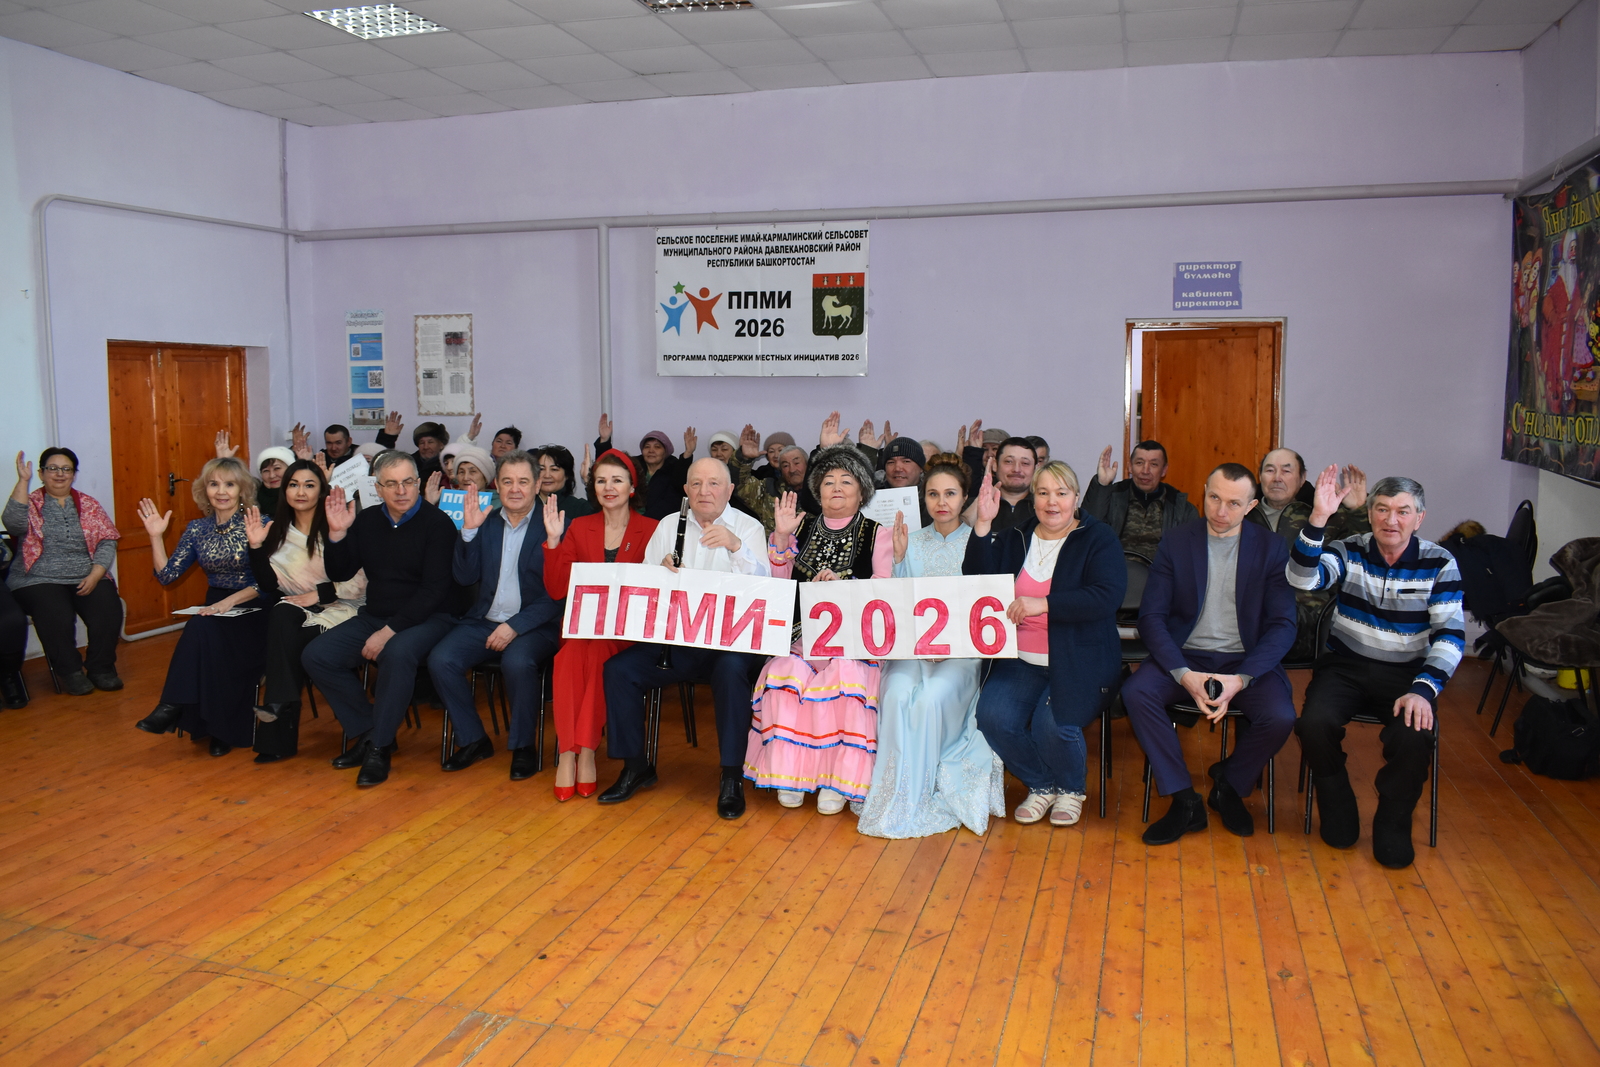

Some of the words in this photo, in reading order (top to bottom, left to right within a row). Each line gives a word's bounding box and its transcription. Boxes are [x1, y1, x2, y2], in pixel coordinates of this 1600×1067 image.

[656, 235, 694, 245] СЕЛЬСКОЕ
[695, 234, 739, 244] ПОСЕЛЕНИЕ
[740, 230, 823, 243] ИМАЙ-КАРМАЛИНСКИЙ
[824, 229, 869, 241] СЕЛЬСОВЕТ
[663, 246, 732, 257] МУНИЦИПАЛЬНОГО
[733, 244, 763, 255] РАЙОНА
[764, 242, 834, 256] ДАВЛЕКАНОВСКИЙ
[835, 241, 861, 252] РАЙОН
[707, 258, 754, 268] РЕСПУБЛИКИ
[756, 257, 816, 267] БАШКОРТОСТАН
[1179, 263, 1237, 271] директор
[728, 290, 792, 310] ППМИ
[1182, 290, 1233, 298] кабинет
[1175, 300, 1239, 308] директора
[734, 318, 785, 338] 2026
[663, 354, 707, 362] ПРОГРАММА
[708, 354, 754, 362] ПОДДЕРЖКИ
[793, 354, 840, 362] ИНИЦИАТИВ
[841, 353, 860, 361] 2026
[442, 492, 489, 505] ППИ
[568, 584, 787, 650] ППМИ-
[809, 596, 1007, 657] 2026
